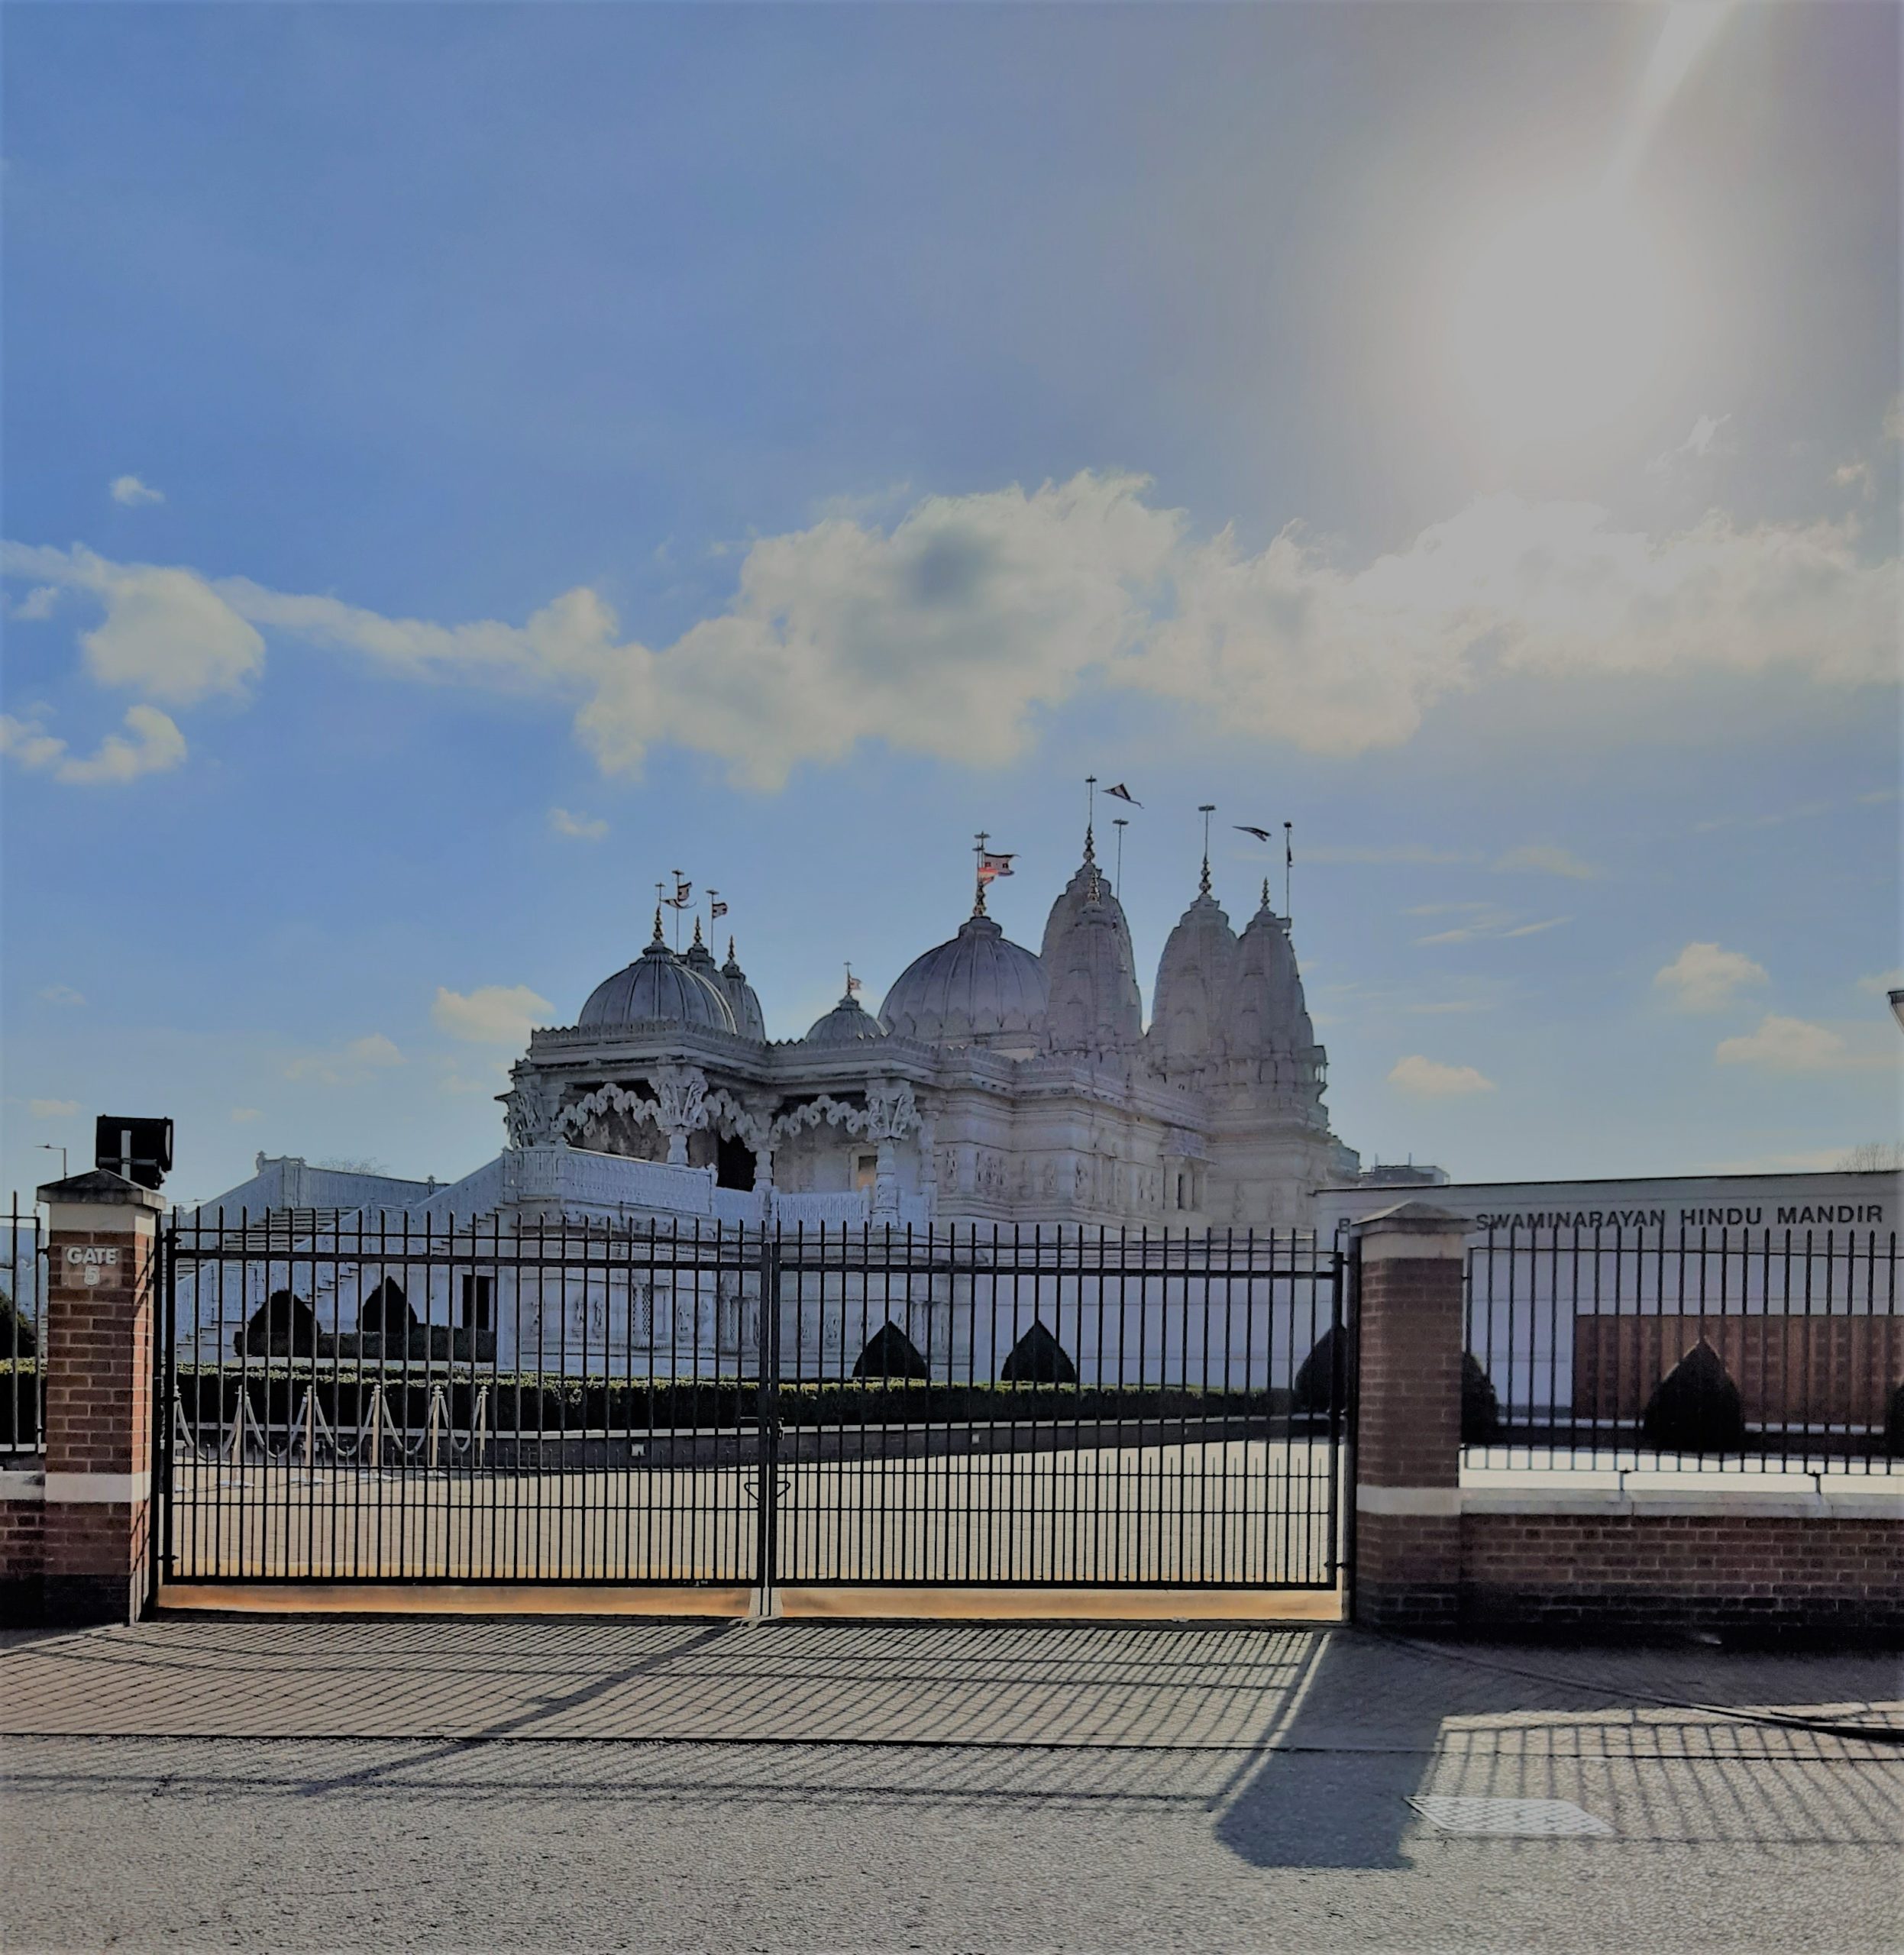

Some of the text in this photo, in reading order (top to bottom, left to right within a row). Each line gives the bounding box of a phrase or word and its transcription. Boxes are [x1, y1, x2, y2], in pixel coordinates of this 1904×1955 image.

[1476, 1205, 1883, 1231] SWAMINARAYAN HINDU MANDIR
[67, 1246, 117, 1265] GATE
[85, 1265, 100, 1285] 5
